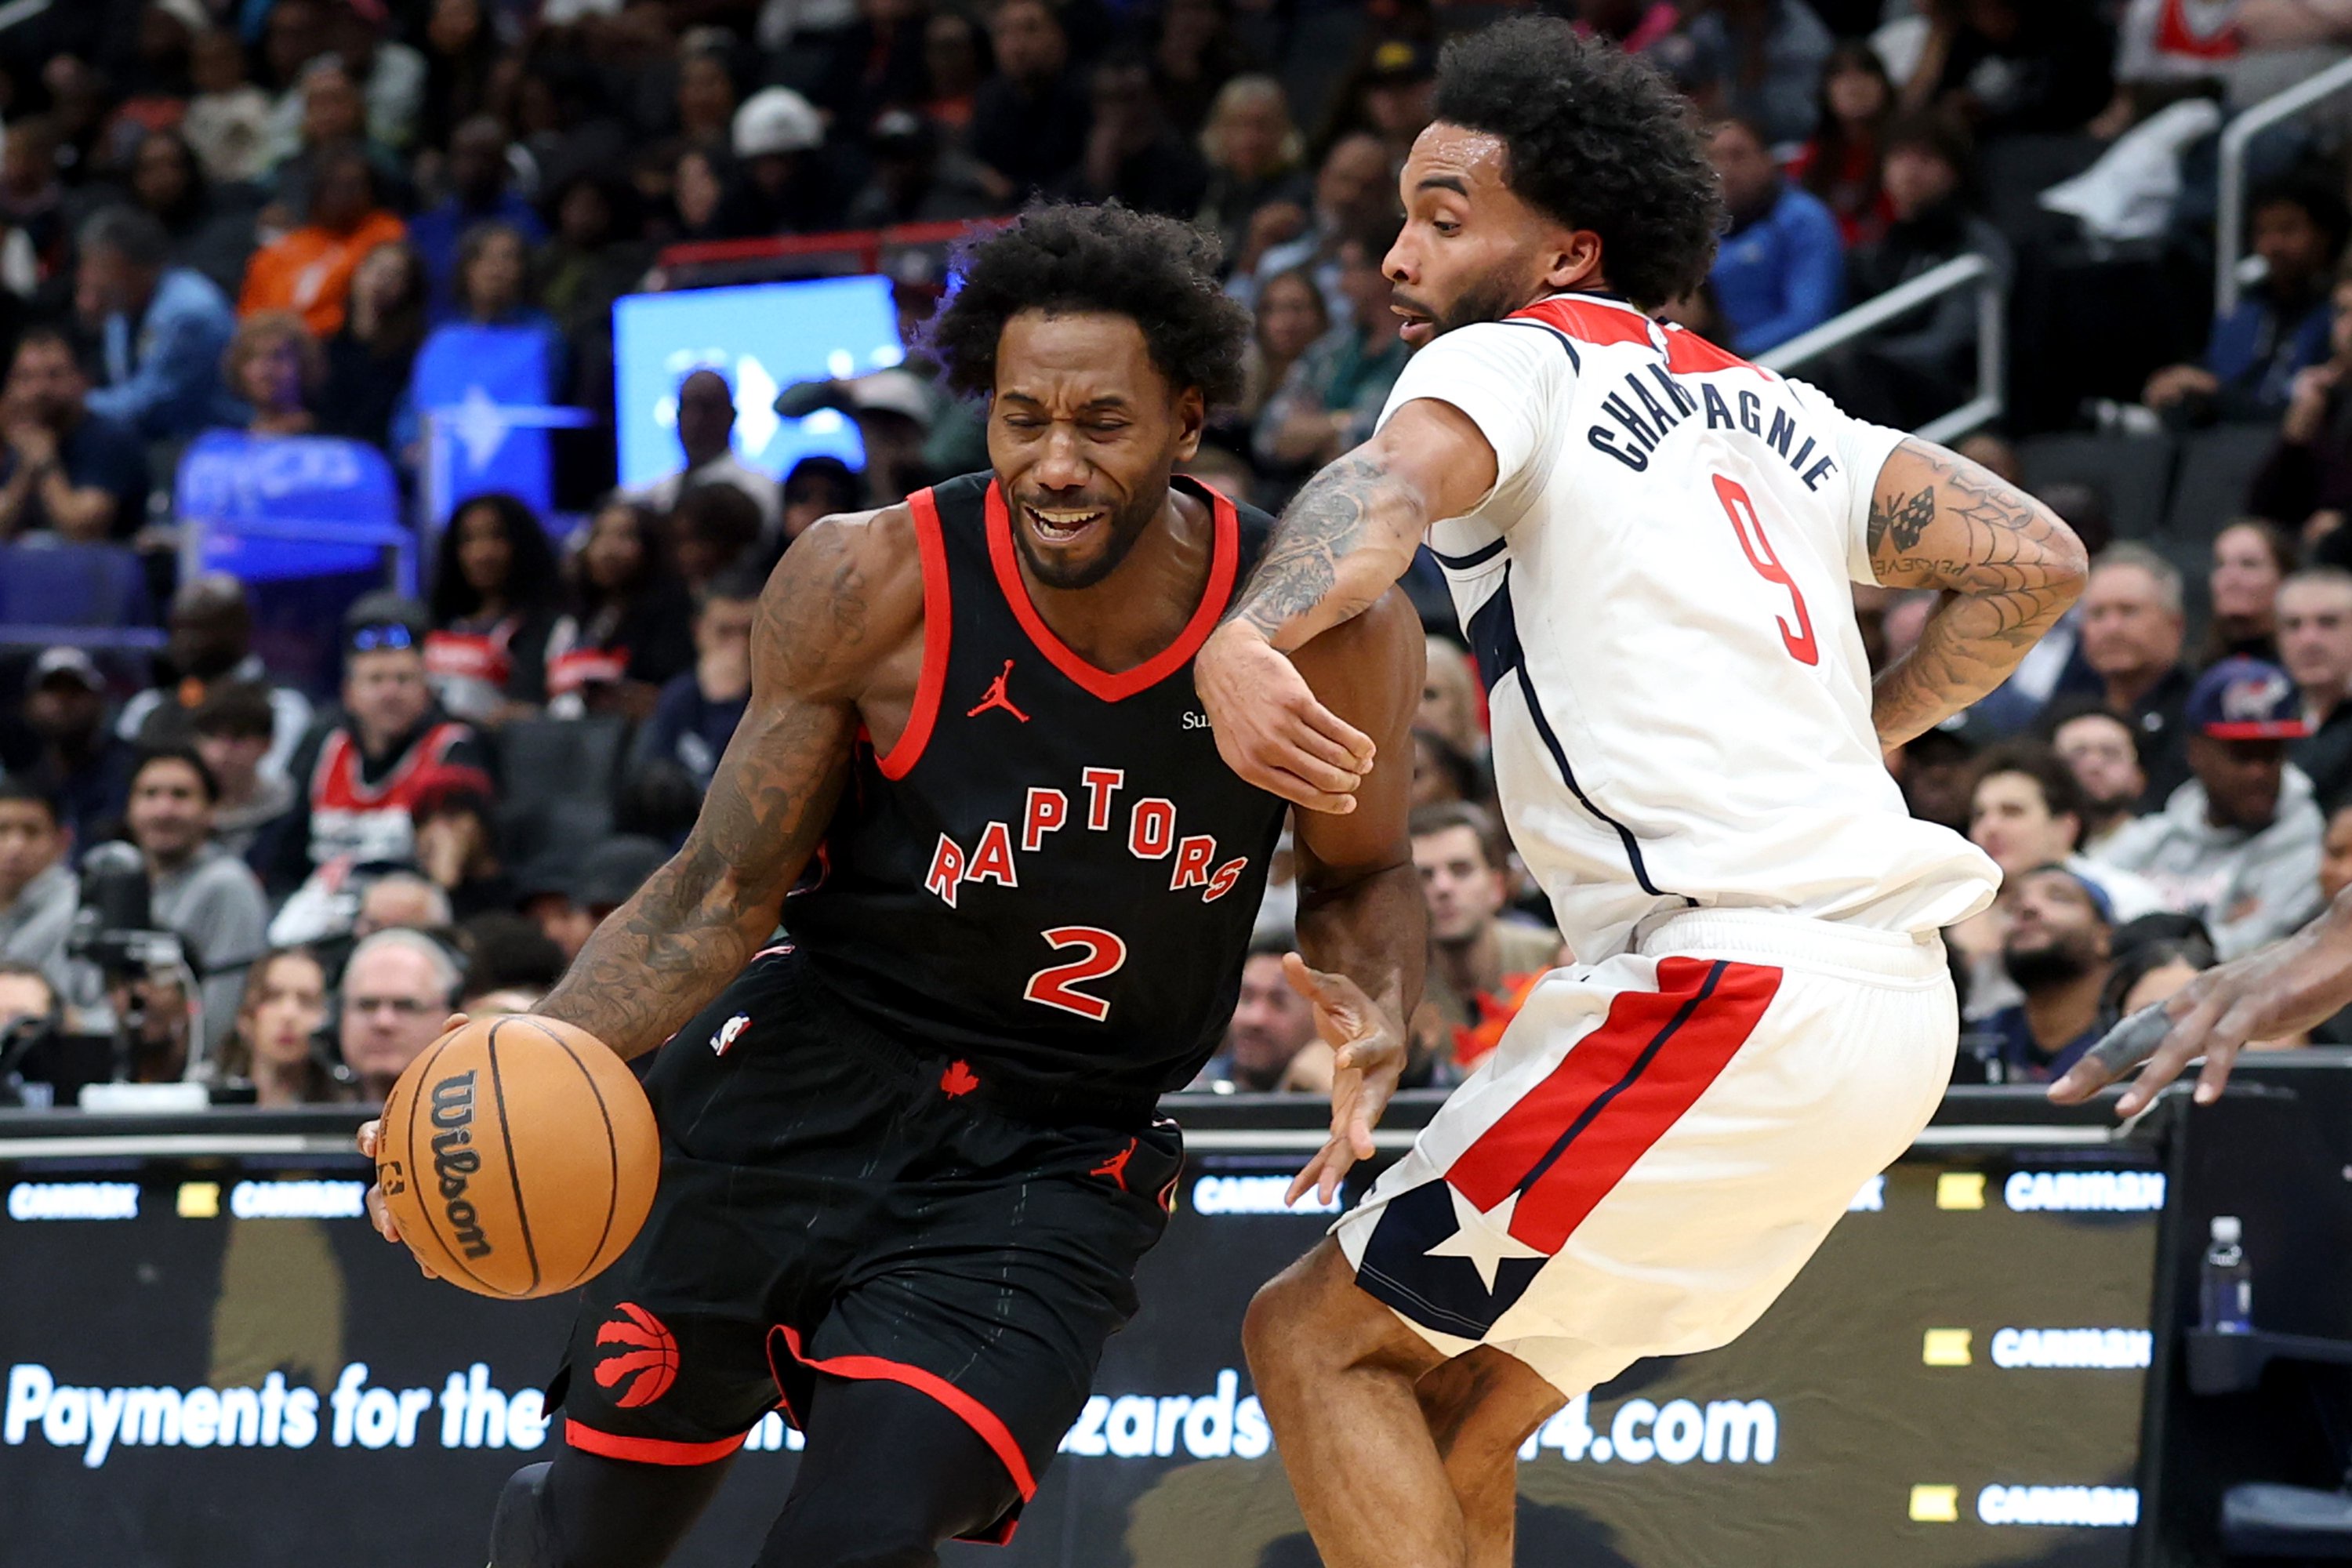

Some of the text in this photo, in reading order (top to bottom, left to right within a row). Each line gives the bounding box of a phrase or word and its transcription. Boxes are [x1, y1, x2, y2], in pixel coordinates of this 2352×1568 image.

[1712, 474, 1819, 666] 9
[1181, 710, 1212, 730] Su
[924, 766, 1248, 909] RAPTORS
[1023, 925, 1127, 1022] 2
[430, 1069, 492, 1261] Wilson
[5, 1364, 319, 1467] Payments
[331, 1363, 432, 1448] for
[440, 1363, 551, 1450] the
[1058, 1368, 1272, 1459] zards
